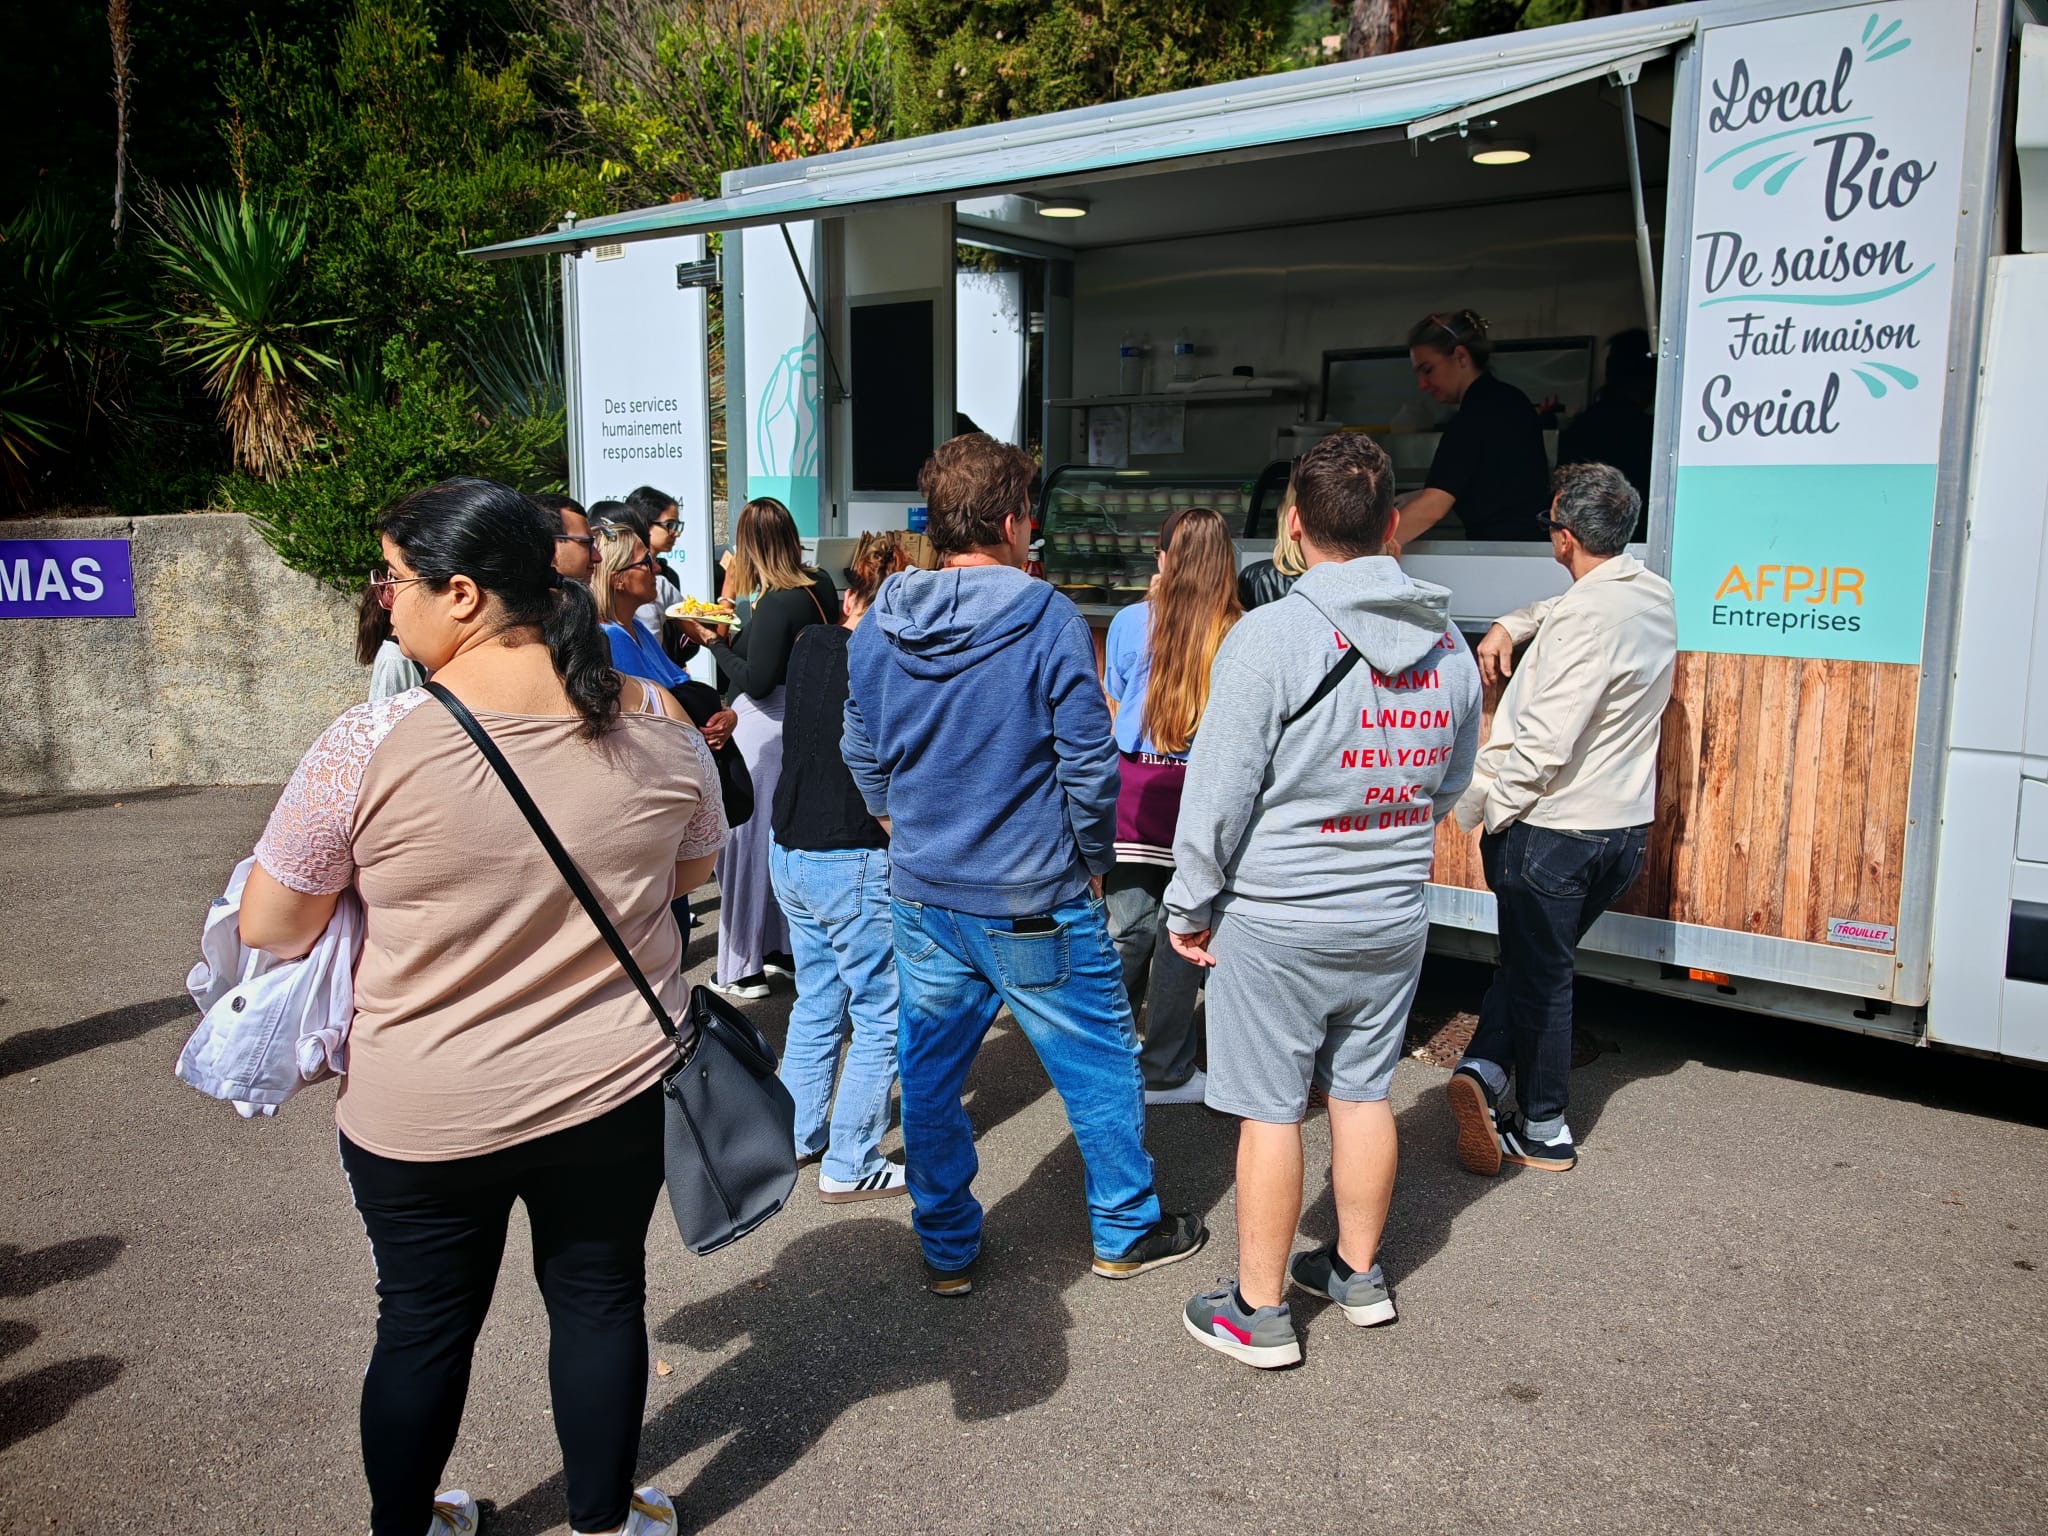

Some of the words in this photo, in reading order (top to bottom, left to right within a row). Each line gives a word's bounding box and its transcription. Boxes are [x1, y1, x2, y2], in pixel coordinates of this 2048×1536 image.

[1709, 46, 1853, 133] Local
[1813, 132, 1937, 222] Bio
[1696, 231, 1763, 294] De
[1771, 235, 1914, 287] saison
[1727, 312, 1796, 360] Fait
[1801, 318, 1921, 353] maison
[605, 398, 626, 414] Des
[629, 396, 678, 413] services
[1697, 371, 1840, 442] Social
[602, 419, 682, 437] humainement
[603, 442, 683, 463] responsables
[1714, 564, 1866, 606] AFPJR
[1712, 604, 1862, 634] Entreprises
[1141, 752, 1170, 766] FILA
[1397, 745, 1452, 768] YORK
[1320, 814, 1369, 833] ABU
[1837, 925, 1889, 940] TROUILLET
